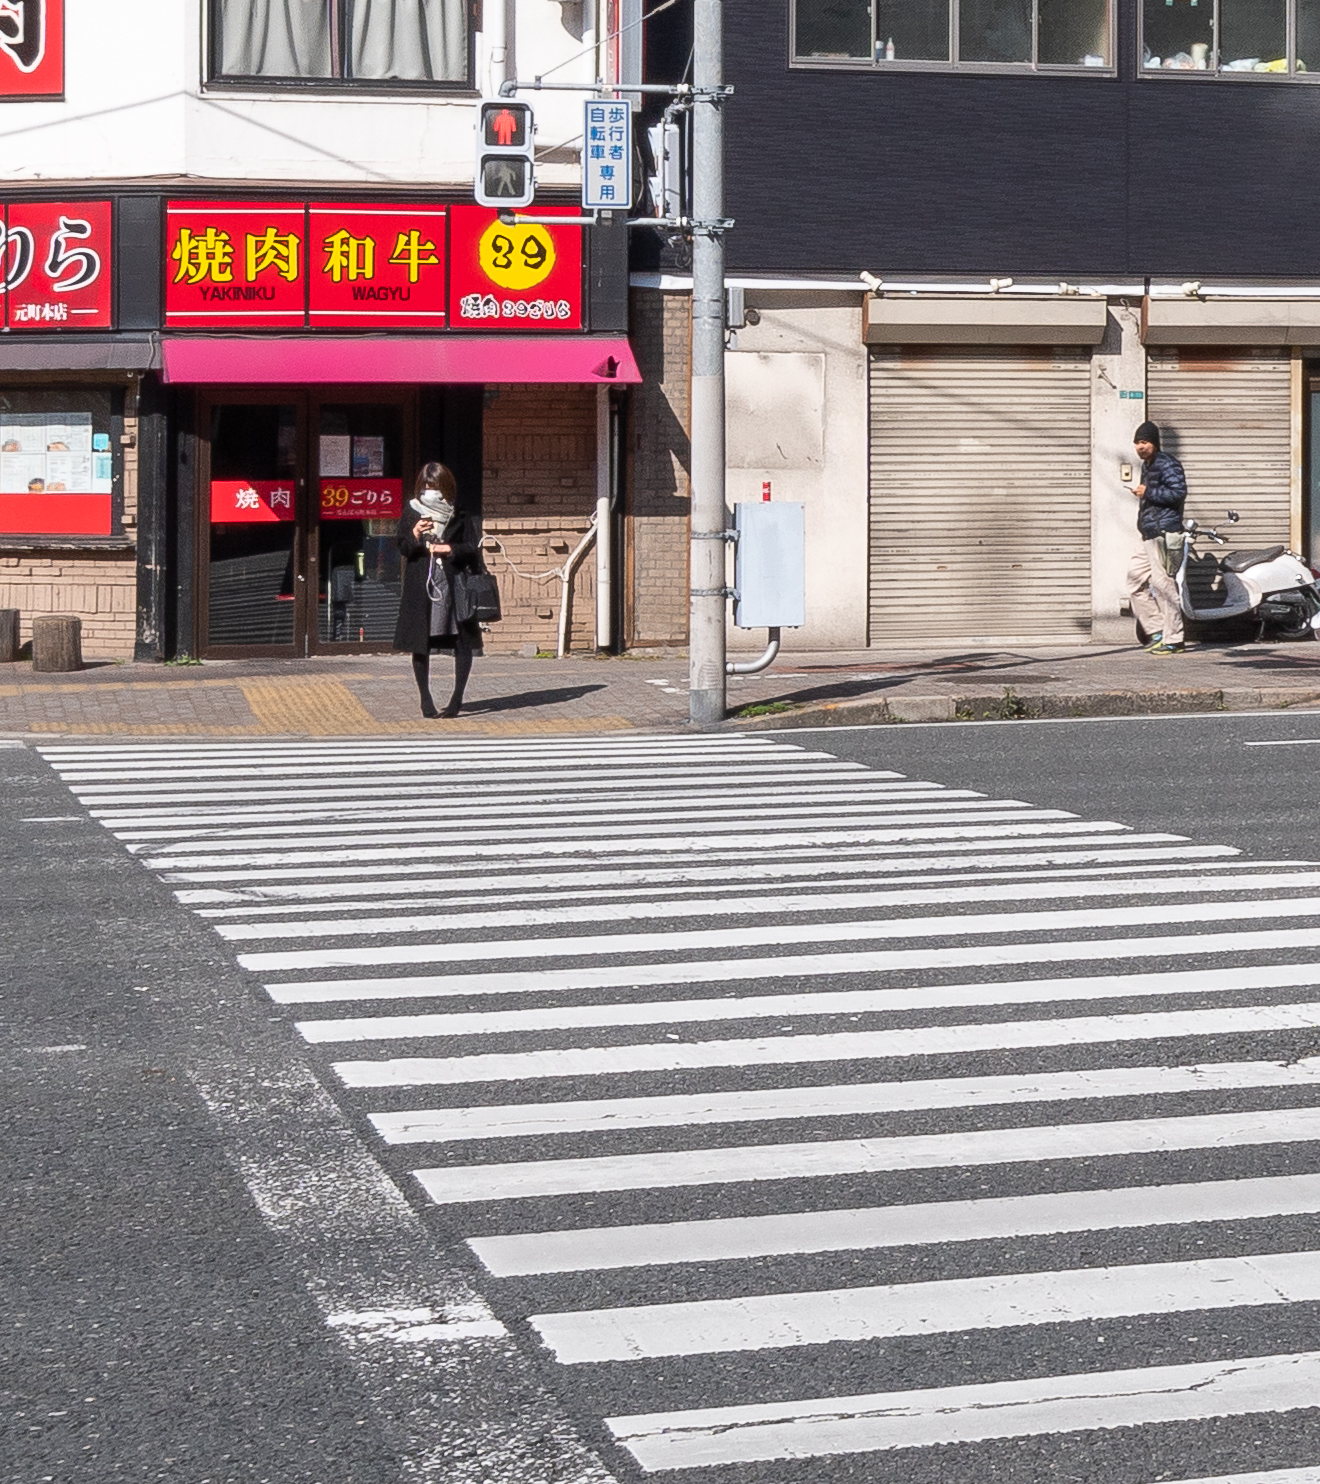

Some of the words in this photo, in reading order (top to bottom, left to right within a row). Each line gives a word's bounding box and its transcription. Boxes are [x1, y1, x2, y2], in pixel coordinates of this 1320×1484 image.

[590, 107, 606, 160] 自転車
[608, 107, 625, 160] 歩行者
[600, 164, 615, 201] 専用
[172, 227, 300, 284] 焼肉
[322, 228, 440, 283] 和牛
[491, 234, 548, 270] 39
[200, 286, 276, 302] YAKINIKU
[351, 286, 411, 302] WAGYU
[235, 486, 291, 510] 焼肉
[321, 485, 392, 508] 39ごりら
